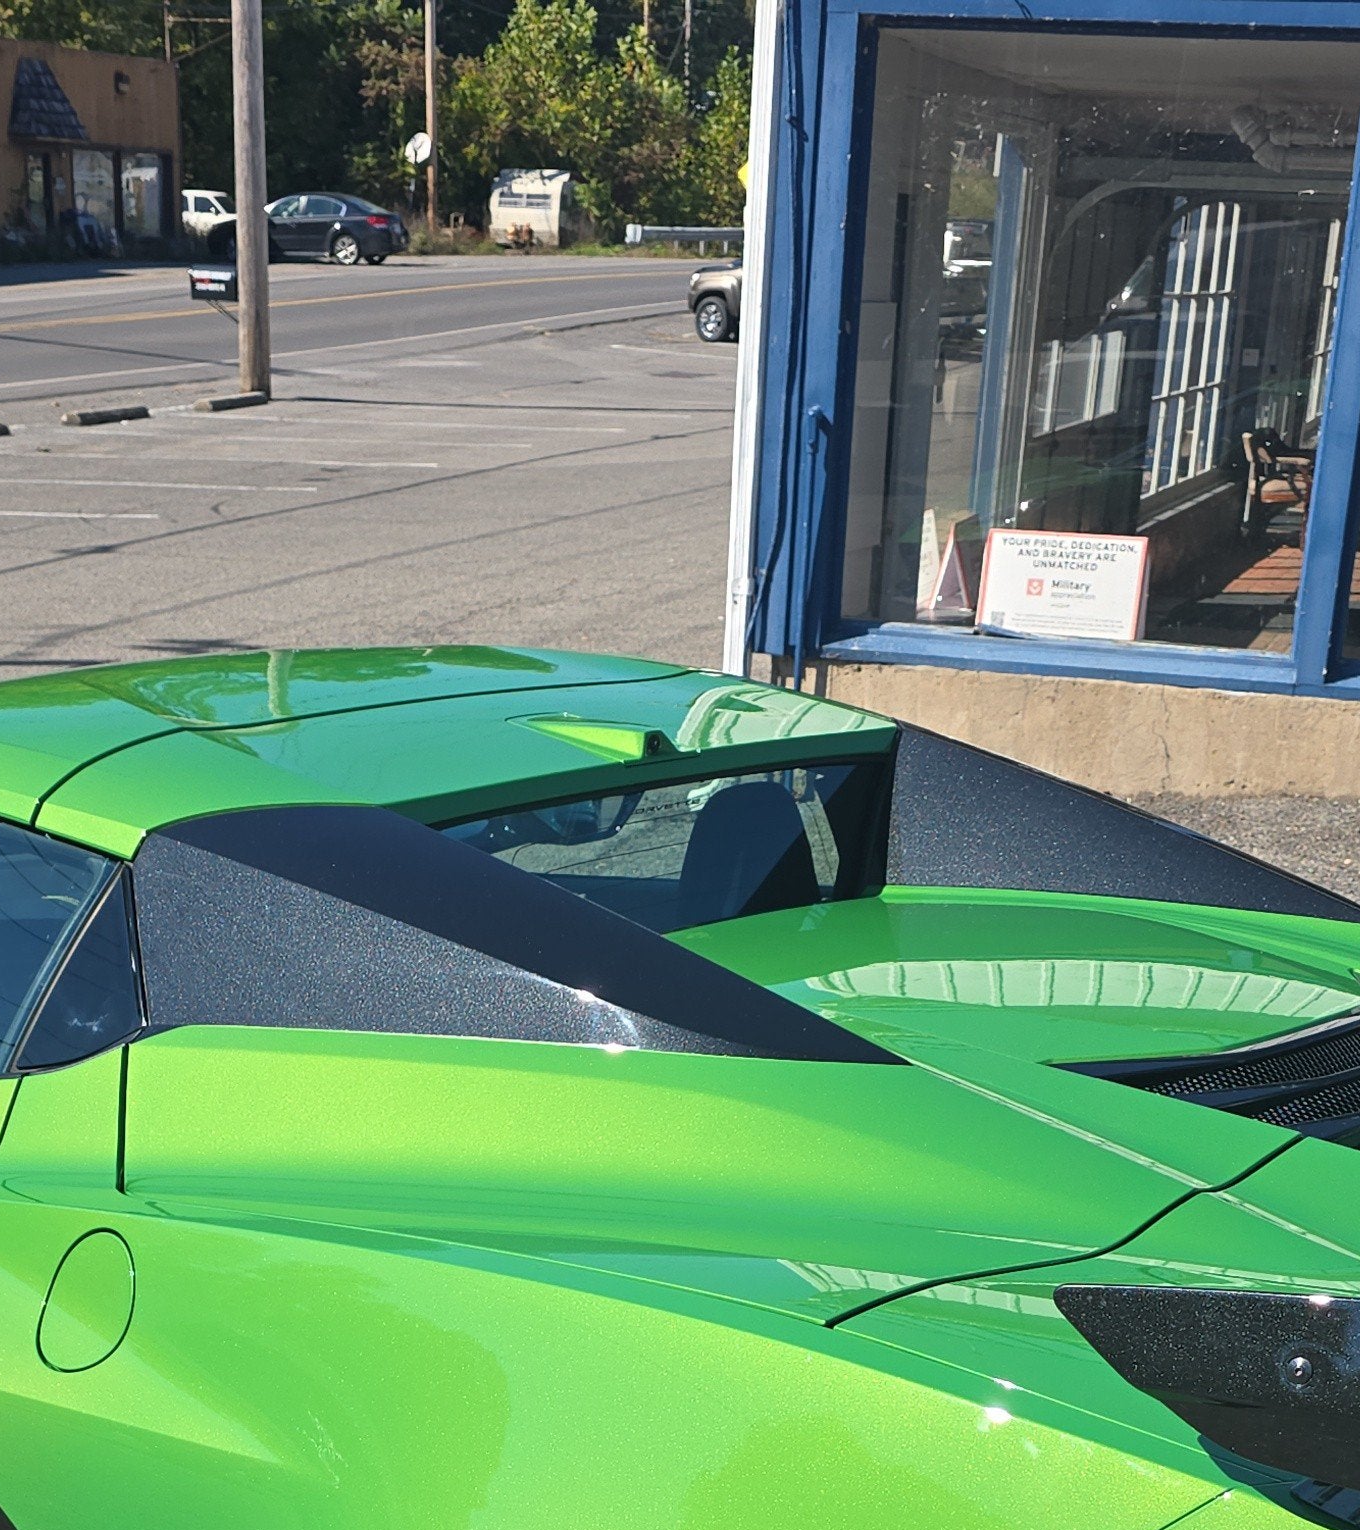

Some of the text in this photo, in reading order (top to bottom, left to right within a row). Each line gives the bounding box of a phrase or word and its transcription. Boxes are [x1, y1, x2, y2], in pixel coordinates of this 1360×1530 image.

[1002, 536, 1031, 547] YOUR
[1018, 548, 1117, 562] AND BRAVERY ARE
[1032, 560, 1098, 572] UNMATCHED
[1051, 579, 1092, 592] Military
